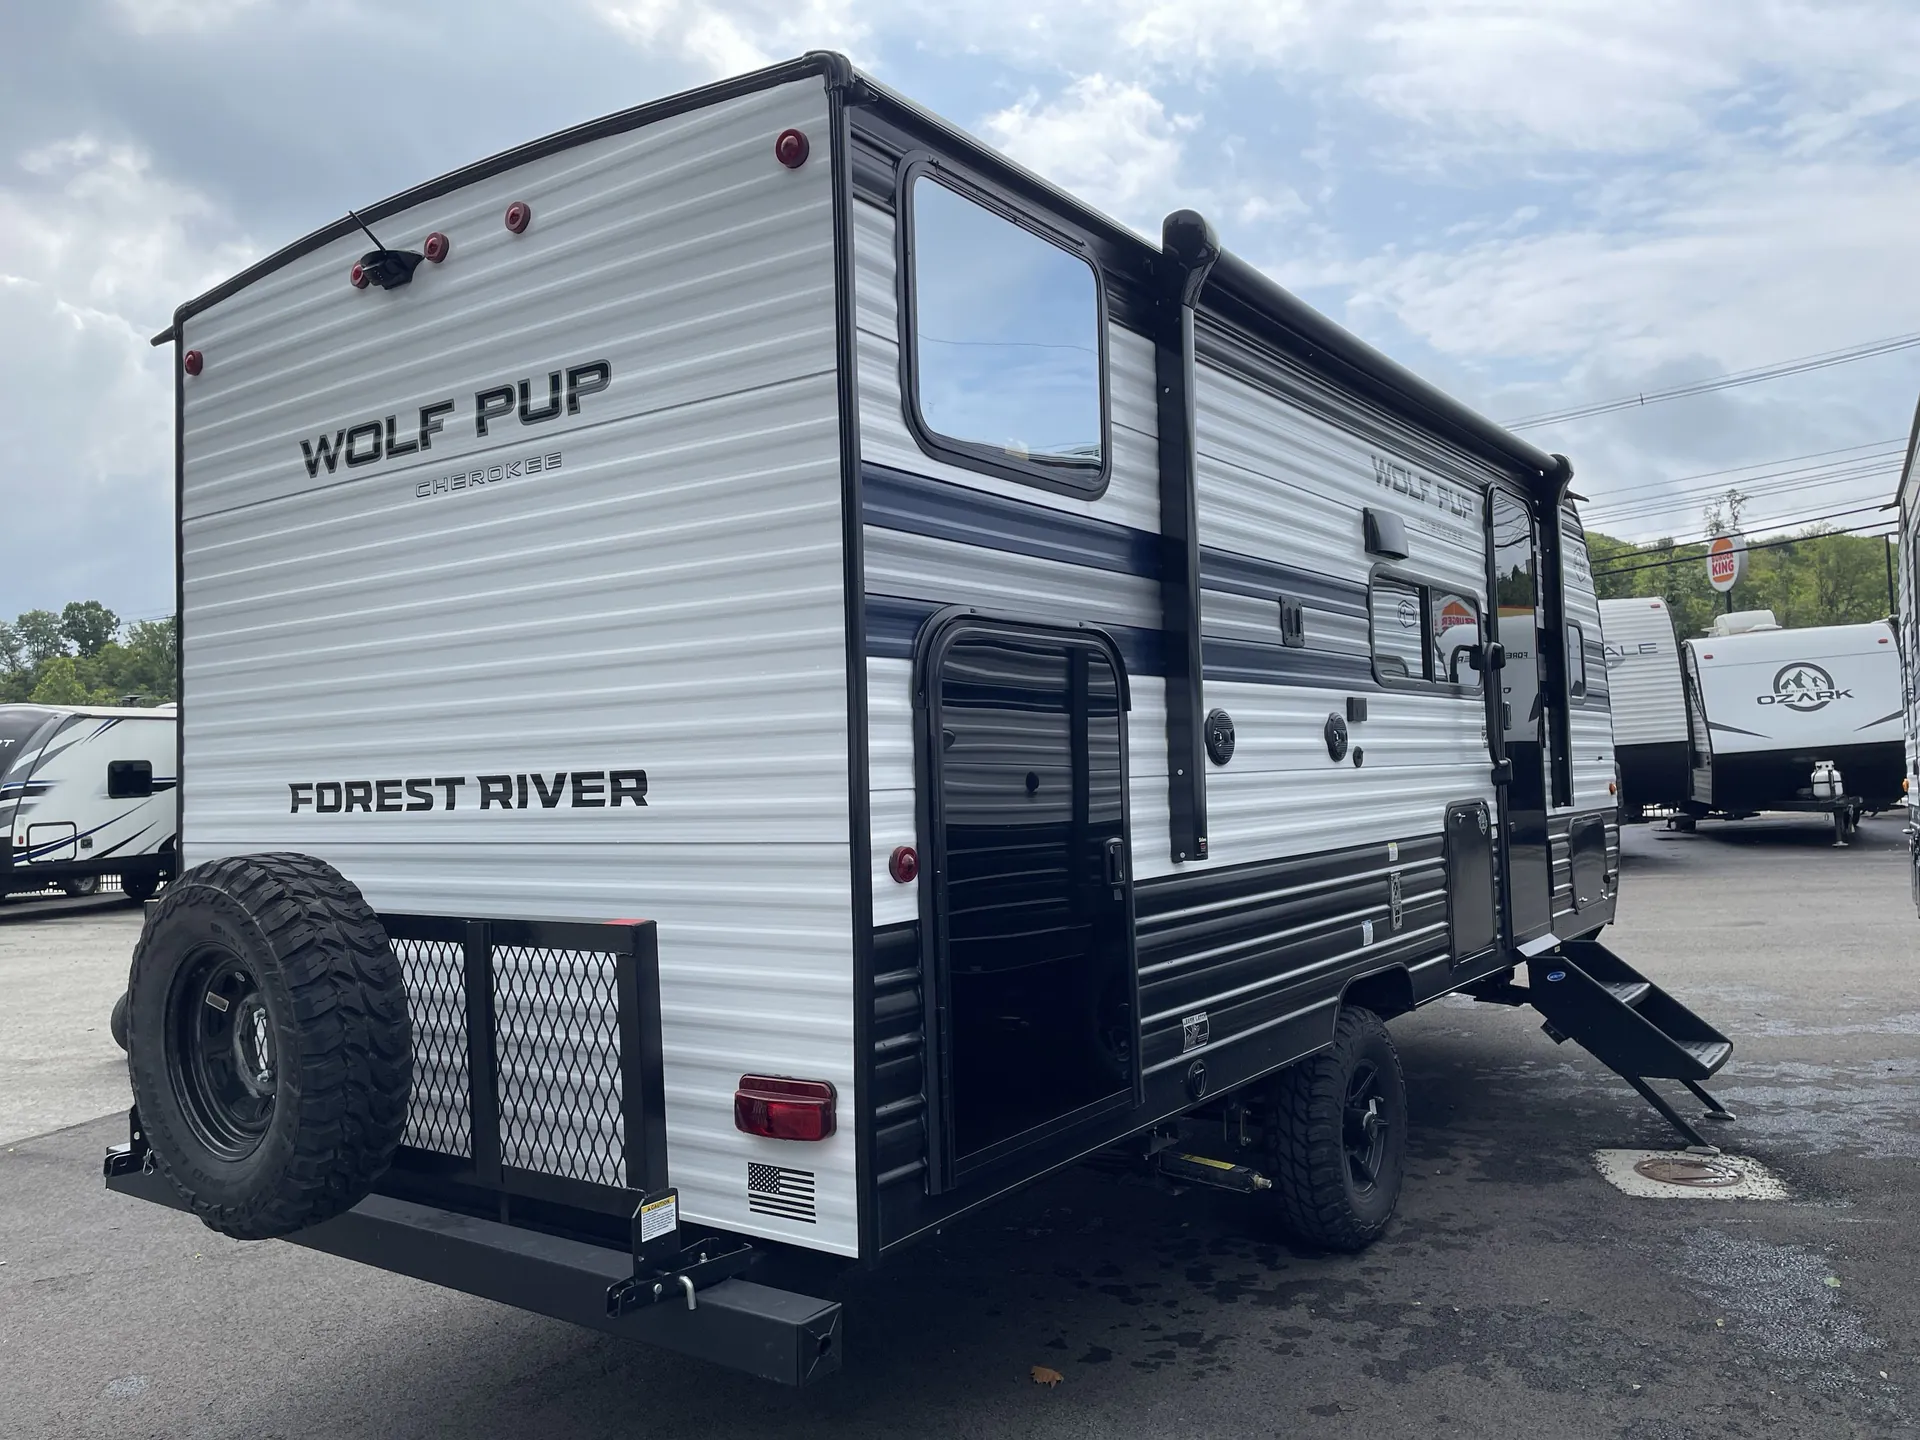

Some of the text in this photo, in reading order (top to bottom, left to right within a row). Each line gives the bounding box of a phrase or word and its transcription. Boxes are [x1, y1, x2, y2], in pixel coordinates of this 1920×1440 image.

[300, 358, 612, 479] WOLF PUP
[415, 451, 562, 498] CHEROKEE
[1371, 454, 1475, 520] WOLF PUP
[1712, 559, 1735, 576] KING
[1756, 689, 1856, 706] OZARK
[288, 769, 649, 814] FOREST RIVER
